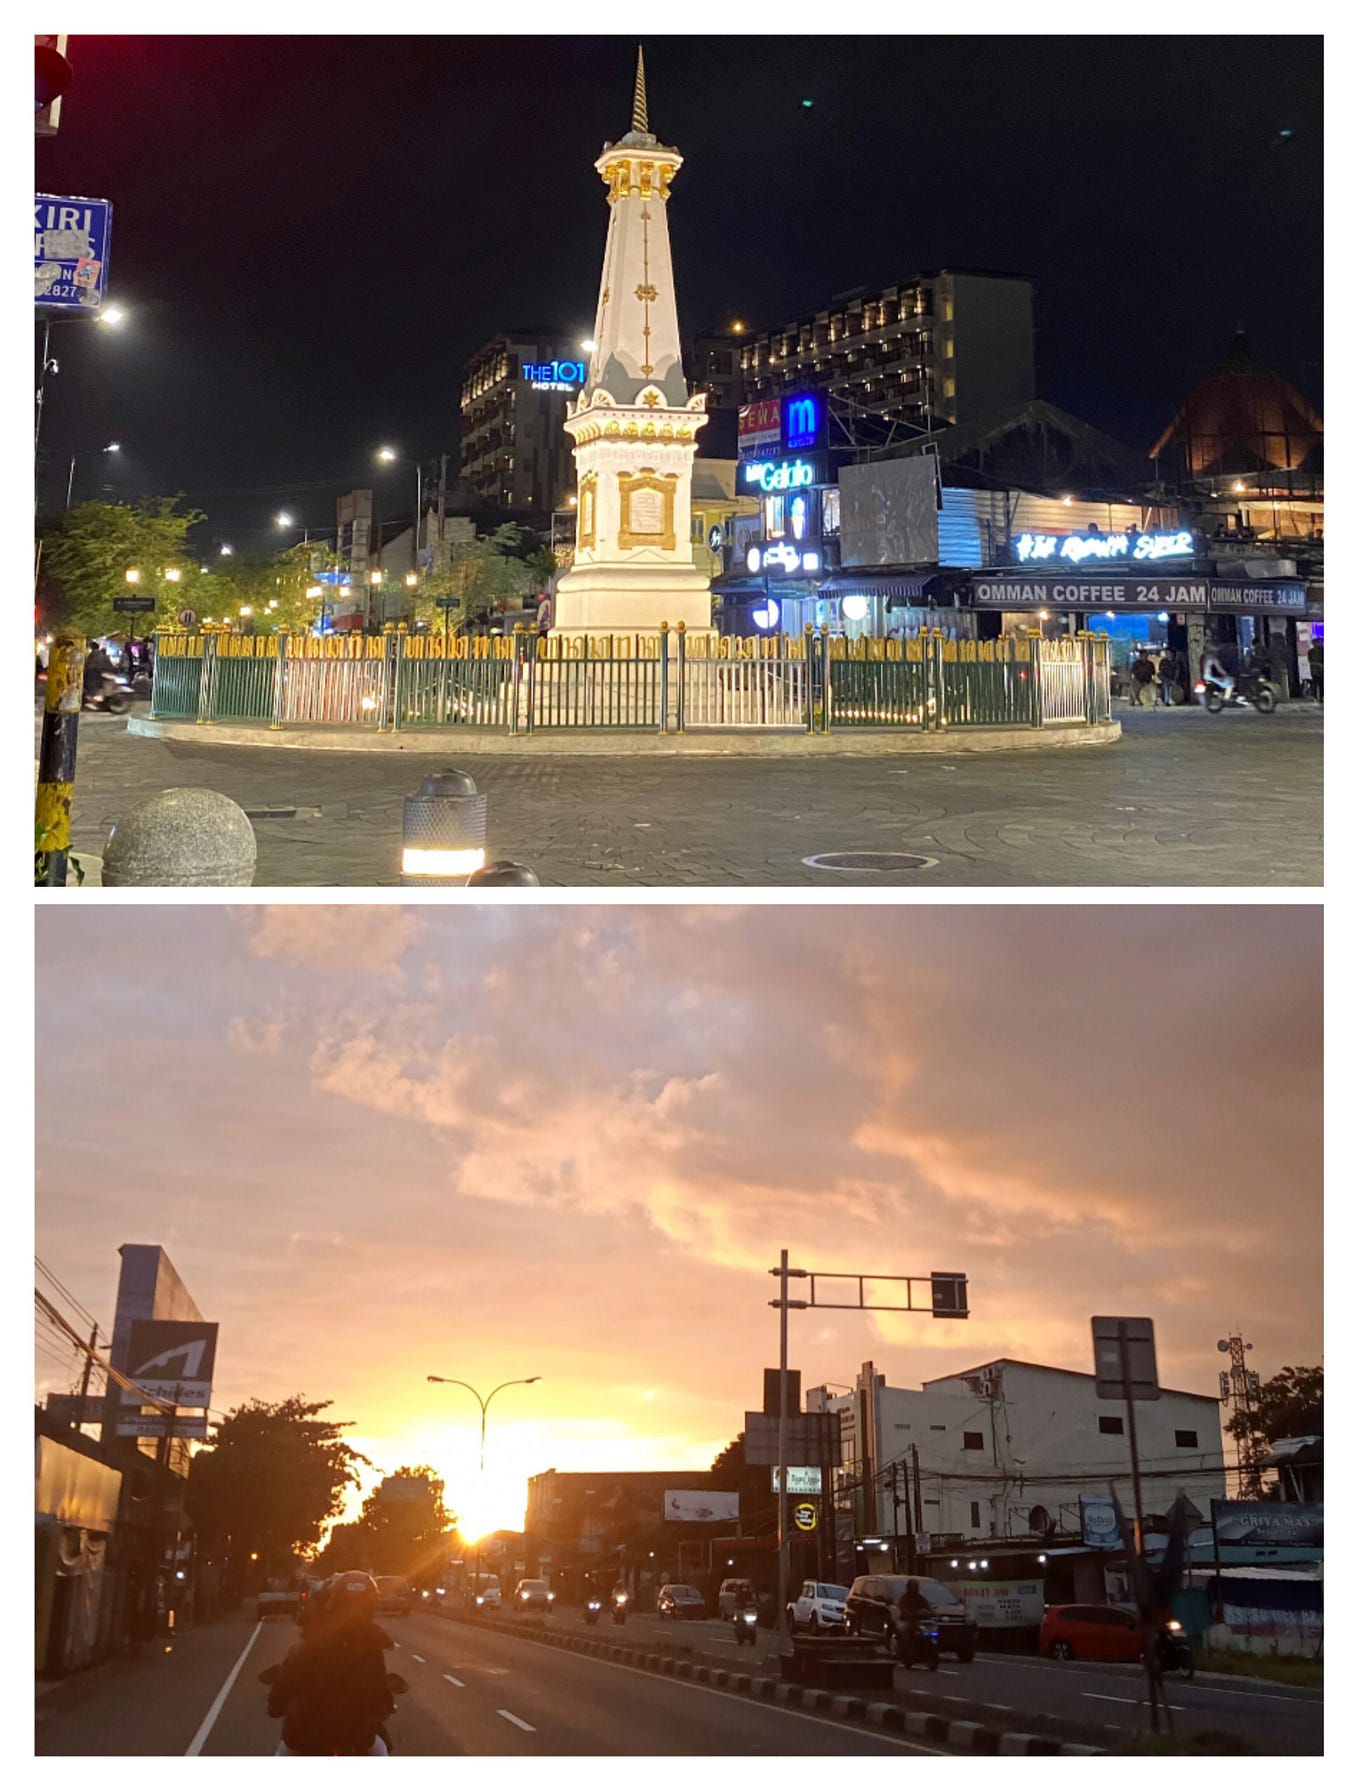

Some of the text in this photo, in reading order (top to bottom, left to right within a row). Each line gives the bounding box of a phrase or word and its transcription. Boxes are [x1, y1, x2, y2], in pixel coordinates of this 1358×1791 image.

[531, 382, 575, 391] HOTEL
[977, 584, 1206, 602] OMMAN COFFEE 24 JAM
[1243, 588, 1274, 604] COFFEE
